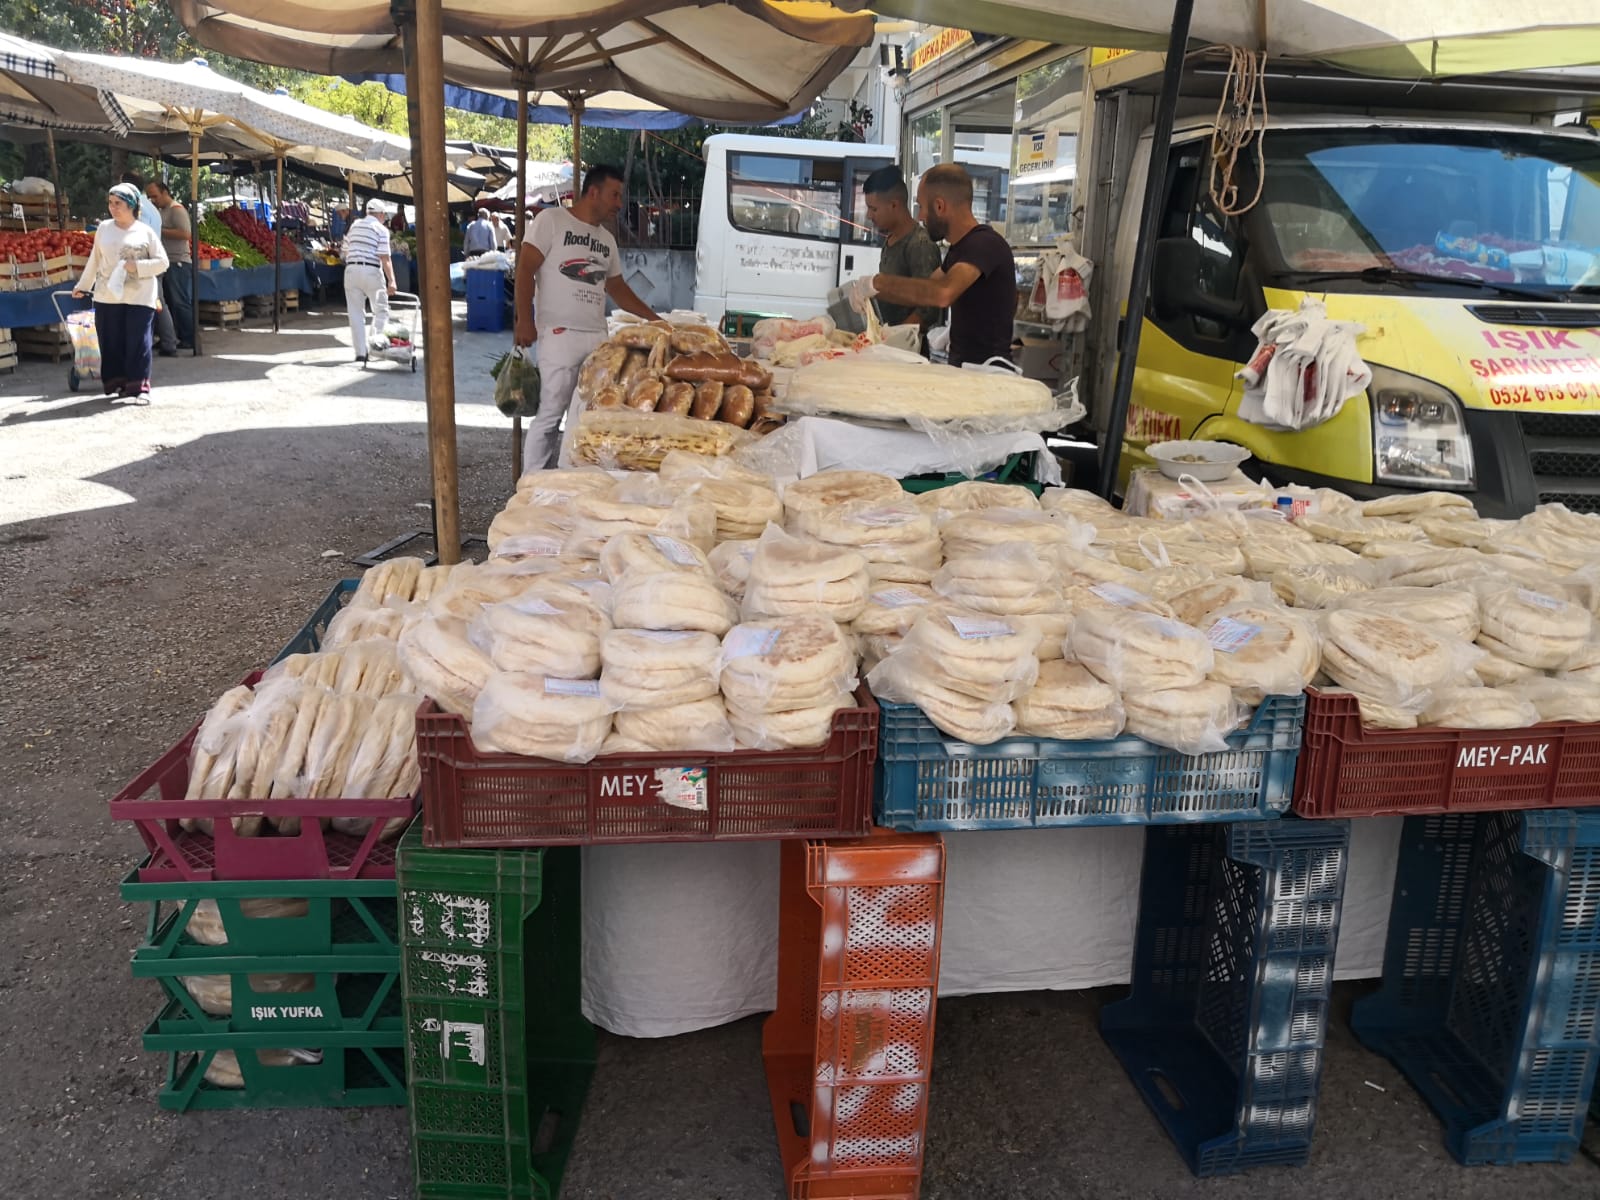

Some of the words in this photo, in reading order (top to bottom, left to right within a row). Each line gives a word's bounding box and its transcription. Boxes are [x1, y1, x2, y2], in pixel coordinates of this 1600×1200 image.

[563, 231, 590, 246] Road
[589, 238, 610, 258] King
[1481, 330, 1582, 354] IŞIK
[1490, 385, 1532, 405] 0532
[1457, 743, 1549, 769] MEY-PAK
[600, 775, 663, 797] MEY-
[251, 1006, 278, 1021] IŞIK
[280, 1006, 323, 1018] YUFKA
